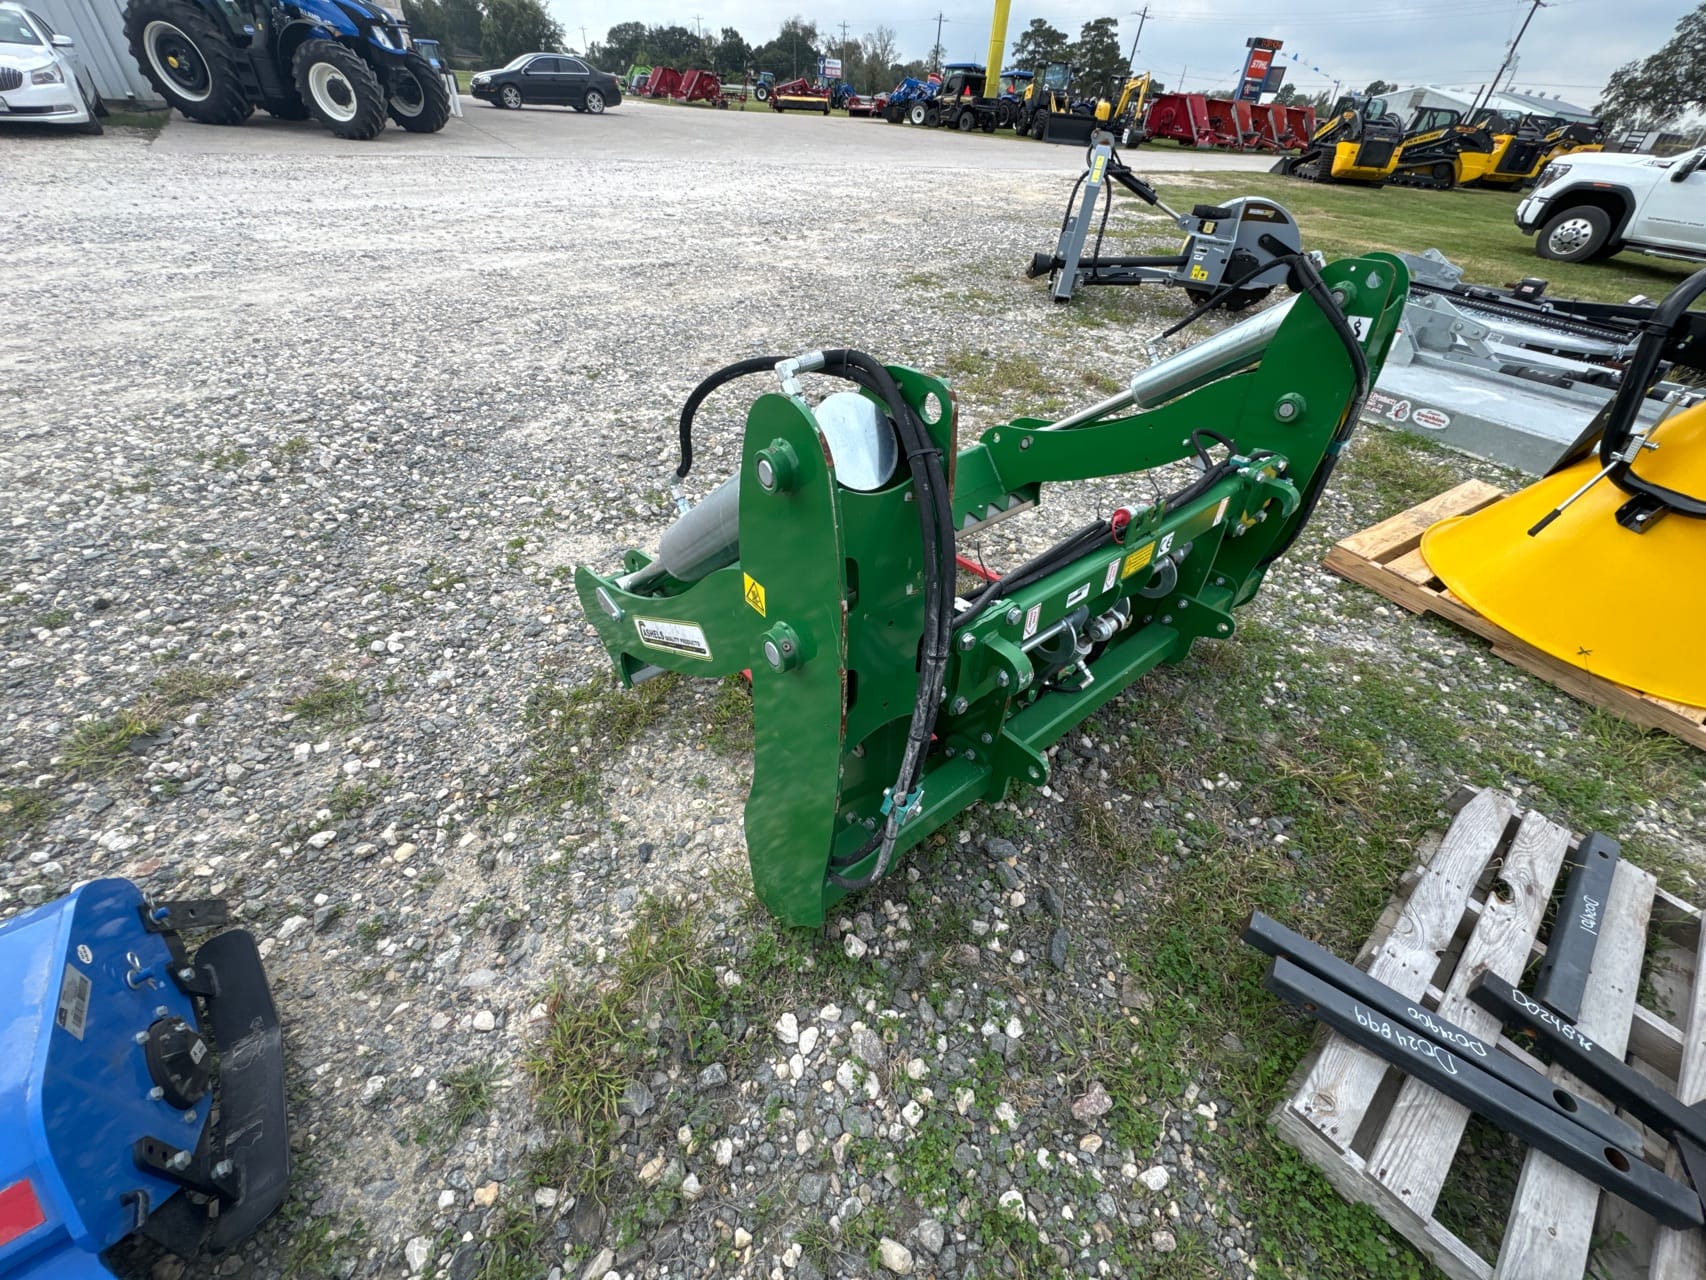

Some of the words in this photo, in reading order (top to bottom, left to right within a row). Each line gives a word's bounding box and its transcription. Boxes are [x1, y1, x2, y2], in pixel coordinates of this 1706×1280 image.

[1251, 59, 1268, 70] STIHL
[1354, 1004, 1458, 1075] D024899
[1407, 1007, 1487, 1057] D024900
